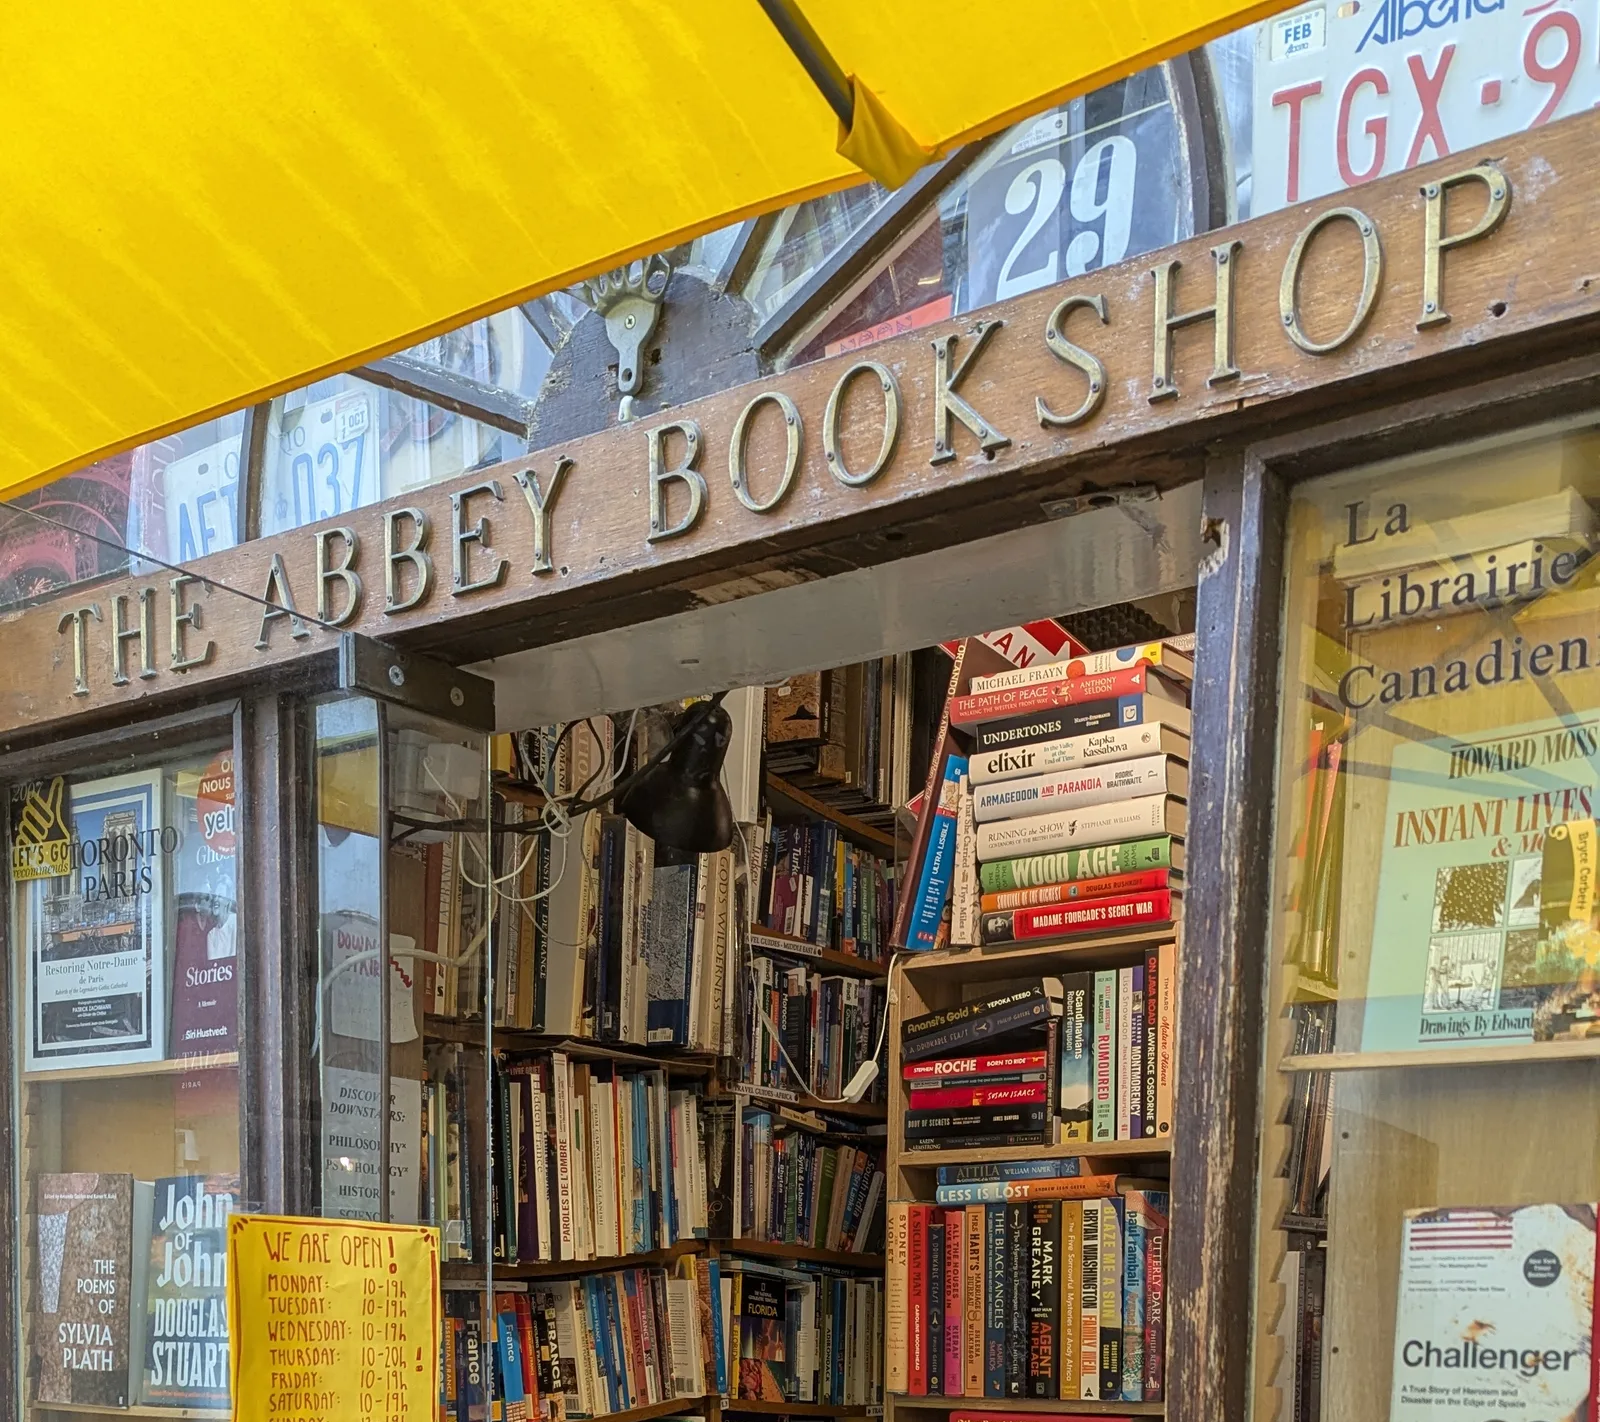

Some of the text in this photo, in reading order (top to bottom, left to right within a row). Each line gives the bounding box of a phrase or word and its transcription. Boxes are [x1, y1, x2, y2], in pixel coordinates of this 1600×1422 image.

[1284, 22, 1312, 44] FEB
[996, 135, 1137, 302] 29
[57, 161, 1512, 697] THE ABBEY BOOKSHOP
[348, 408, 366, 428] OCT
[1344, 501, 1410, 548] La
[1342, 544, 1576, 631] Librairie
[976, 666, 1063, 691] MICHAEL FRAYN
[1080, 676, 1116, 689] ANTHONY
[1338, 636, 1600, 711] Canadien
[959, 686, 1048, 710] THE PATH OF PEACE
[1084, 684, 1113, 695] SELDON
[983, 720, 1062, 745] UNDERTONES
[1088, 734, 1115, 748] Kapka
[987, 748, 1036, 774] elixir
[1083, 742, 1128, 758] Kassabova
[1449, 726, 1599, 780] HOWARD MOSS
[202, 777, 231, 794] NOUS
[980, 777, 1102, 808] ARMAGEDDON AND PARANOIA
[1393, 785, 1592, 848] INSTANT LIVES
[12, 841, 69, 867] LET'S GO
[67, 826, 178, 870] TORONTO
[12, 862, 69, 880] recommends
[1011, 844, 1121, 888] WOOD AGE
[84, 867, 153, 902] PARIS
[1033, 901, 1153, 928] MADAME FOURCADE'S SECRET WAR
[45, 955, 138, 977] Restoring Notre-Dame
[185, 963, 233, 987] Stories
[79, 973, 104, 985] de Paris
[986, 990, 1031, 1009] YEPOKA YEEBO
[185, 1026, 228, 1040] Siri Hustvedt
[1074, 989, 1085, 1060] Scandinavians
[1419, 1009, 1534, 1037] Drawings By Edward
[934, 1059, 977, 1075] ROCHE
[1098, 1034, 1110, 1100] RUMOURED
[559, 1138, 571, 1242] PAROLES DE L'OMBRE
[940, 1185, 1030, 1202] LESS IS LOST
[159, 1182, 233, 1231] John
[174, 1232, 193, 1250] OF
[263, 1231, 292, 1263] WE
[299, 1233, 331, 1264] ARE
[94, 1260, 115, 1275] THE
[156, 1241, 227, 1288] John
[1031, 1226, 1041, 1300] GREANEY
[1043, 1240, 1053, 1286] MARK
[77, 1278, 115, 1294] POEMS
[267, 1274, 329, 1293] MONDAY:
[98, 1299, 115, 1314] OF
[268, 1297, 331, 1315] TUESDAY:
[748, 1303, 778, 1317] FLORIDA
[58, 1323, 113, 1347] SYLVIA
[268, 1320, 352, 1342] WEDNESDAY:
[505, 1324, 514, 1363] France
[63, 1347, 113, 1371] PLATH
[151, 1341, 230, 1388] STUART
[269, 1348, 341, 1366] THURSDAY:
[467, 1319, 480, 1385] France
[547, 1321, 562, 1389] FRANCE
[1402, 1340, 1575, 1377] Challenger
[271, 1371, 323, 1389] FRIDAY:
[269, 1392, 341, 1412] SATURDAY:
